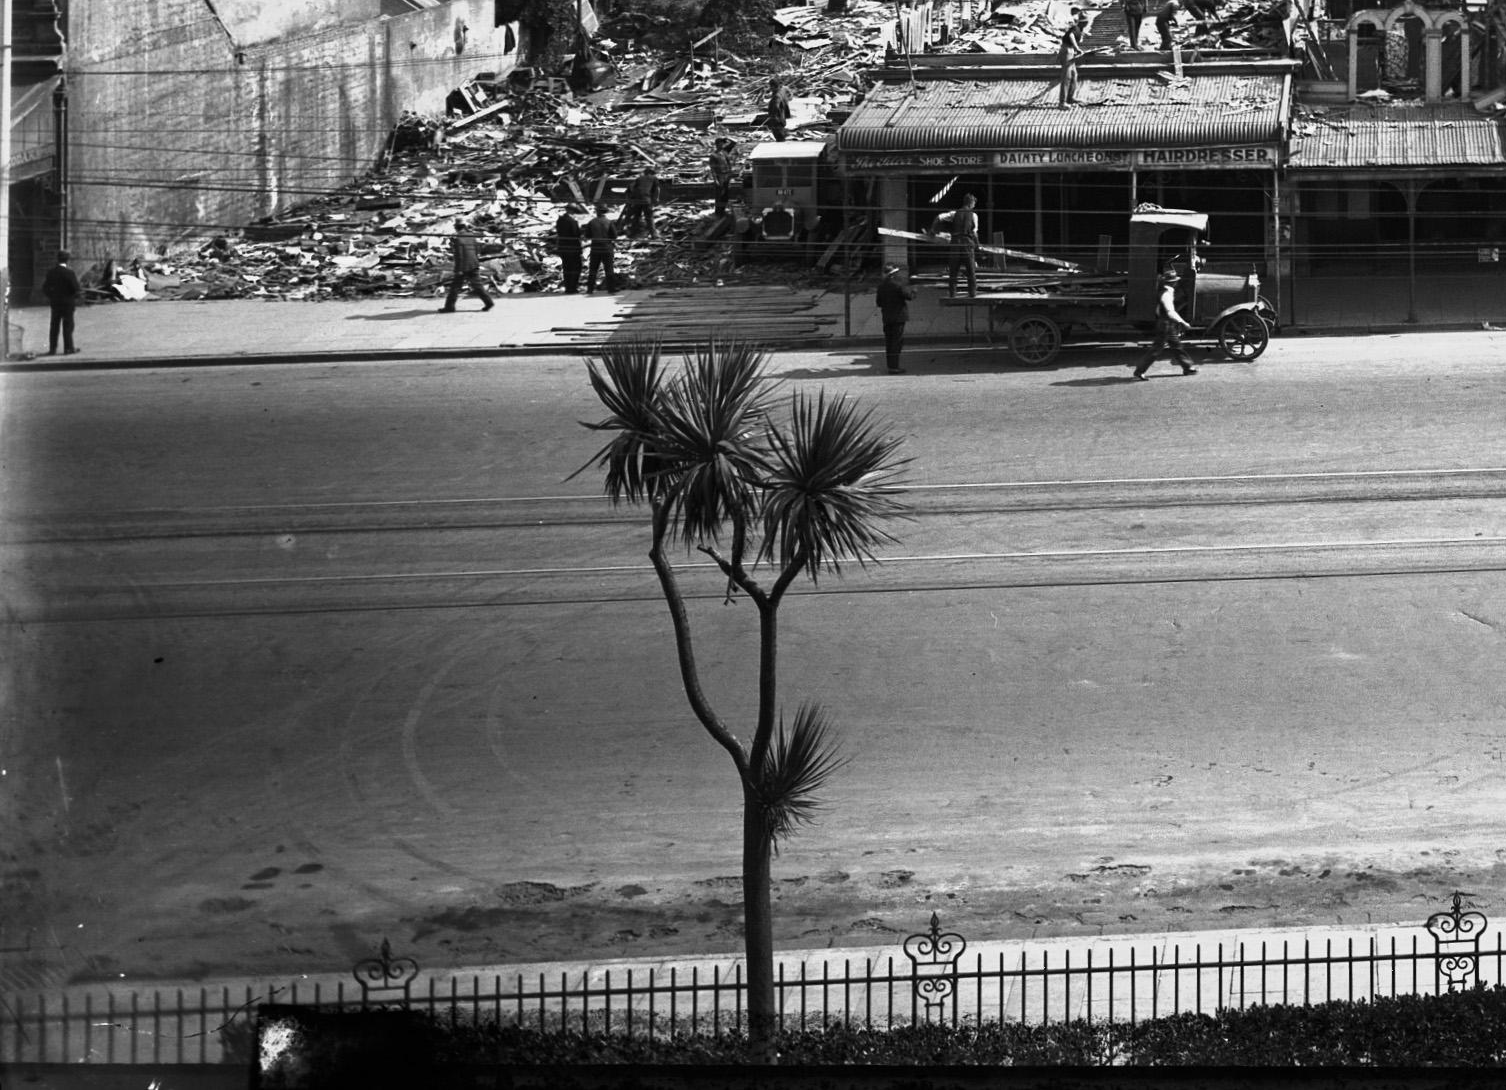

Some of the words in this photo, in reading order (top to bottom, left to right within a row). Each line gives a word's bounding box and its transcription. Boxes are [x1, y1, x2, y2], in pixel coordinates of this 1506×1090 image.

[920, 157, 945, 166] SHOE
[949, 156, 984, 166] STORE
[1000, 152, 1044, 163] DAINTY
